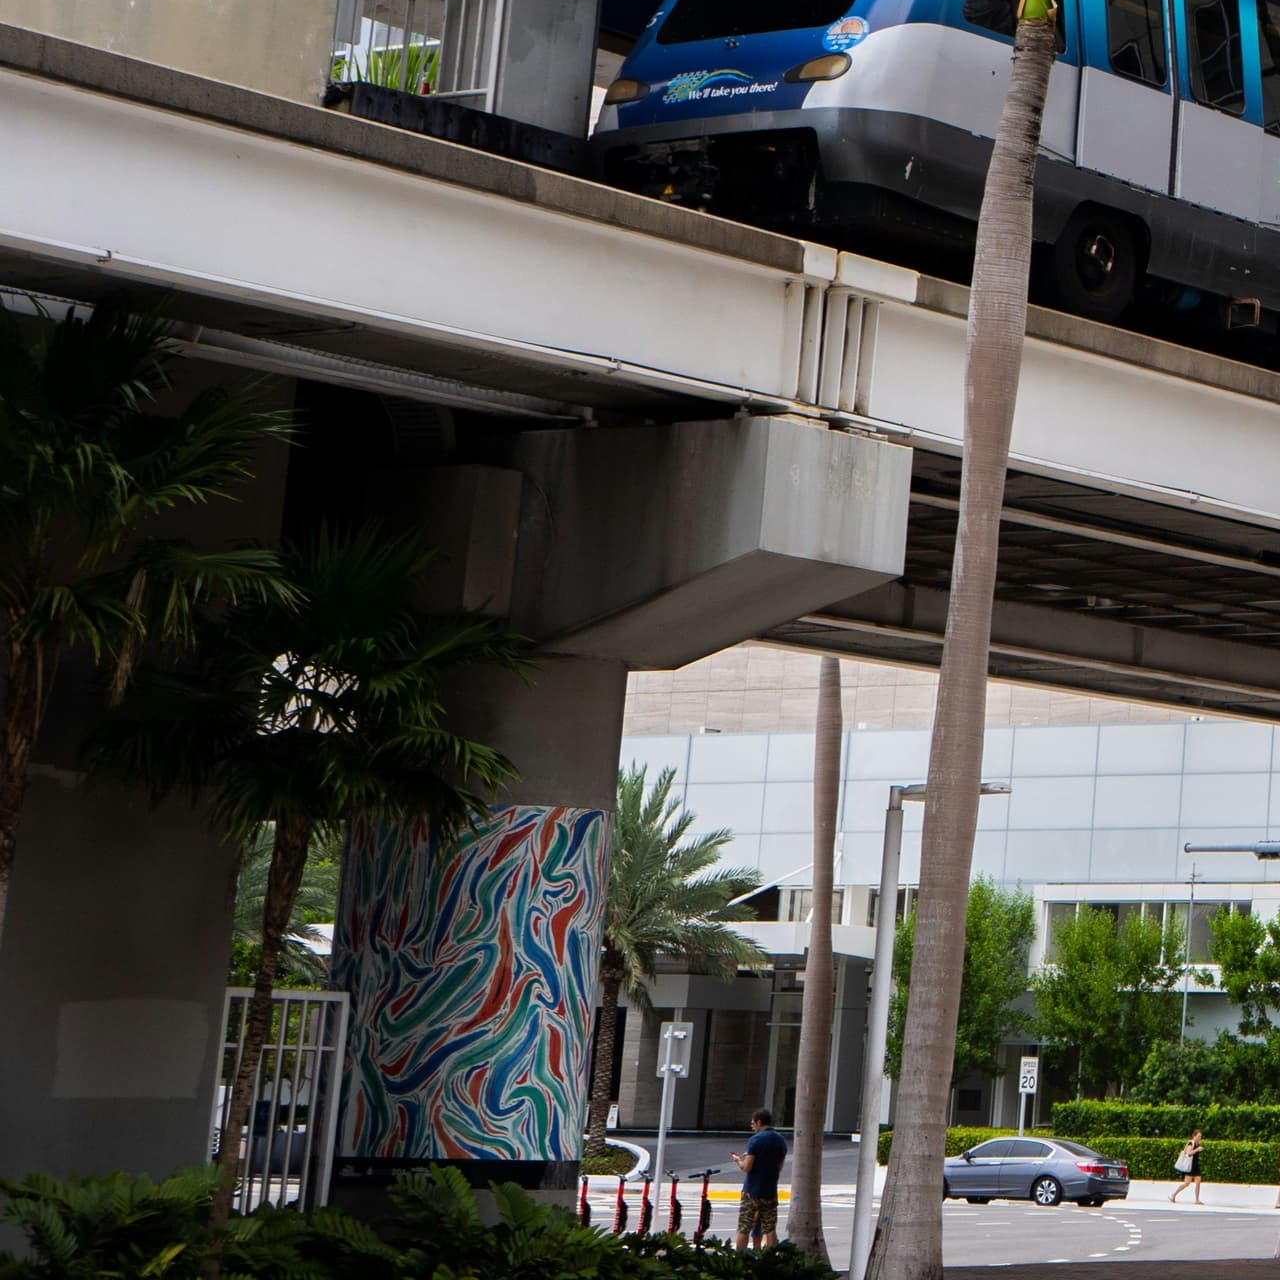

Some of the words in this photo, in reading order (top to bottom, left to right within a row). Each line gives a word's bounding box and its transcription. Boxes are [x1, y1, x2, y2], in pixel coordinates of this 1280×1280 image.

[688, 87, 711, 100] We'll
[710, 86, 730, 98] take
[729, 85, 749, 99] you
[749, 81, 779, 94] there!
[1021, 1075, 1036, 1089] 20
